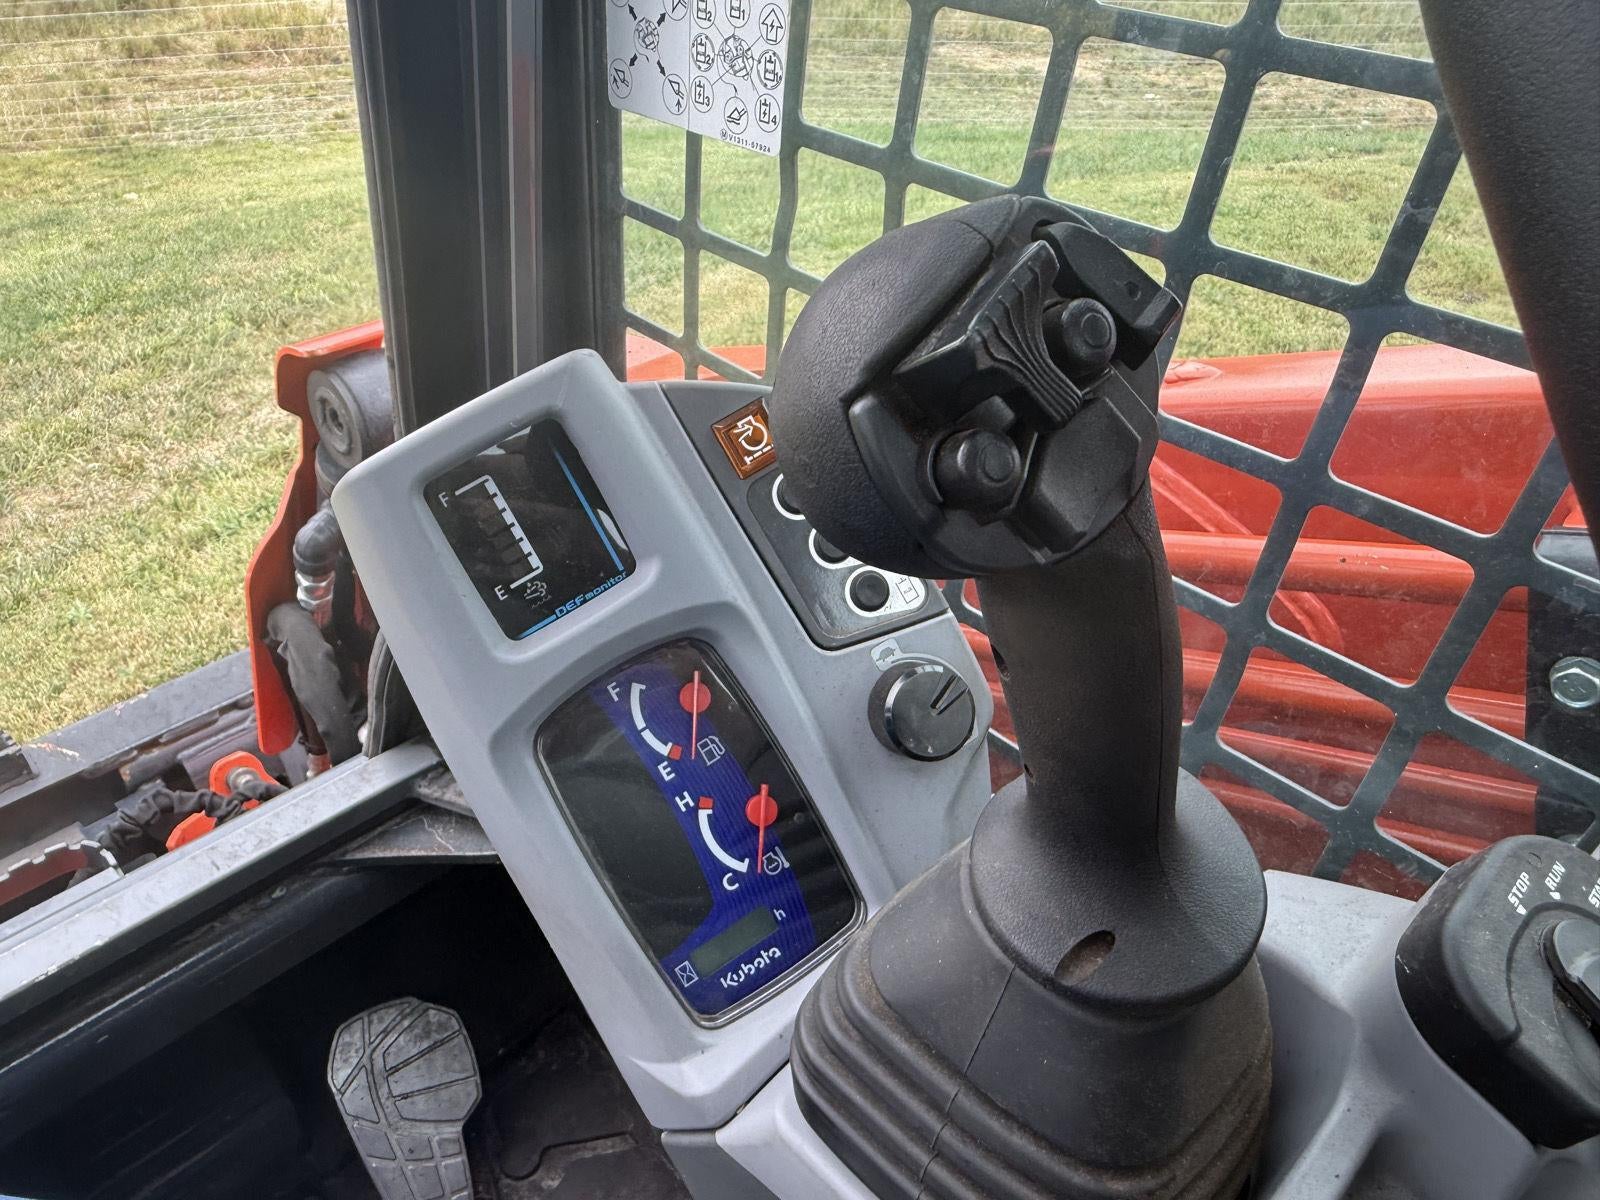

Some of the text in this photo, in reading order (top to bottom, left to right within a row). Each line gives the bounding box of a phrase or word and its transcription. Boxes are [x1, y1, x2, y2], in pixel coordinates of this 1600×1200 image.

[705, 11, 713, 22] 2
[704, 96, 711, 107] 3
[771, 114, 778, 126] 4
[438, 491, 449, 508] F
[494, 585, 508, 600] E
[606, 682, 621, 702] F
[657, 761, 676, 782] E
[674, 790, 695, 812] H
[722, 872, 739, 891] C
[1544, 860, 1566, 891] RUN
[1507, 871, 1530, 907] STOP
[773, 908, 786, 921] h
[720, 946, 782, 988] Kubota
